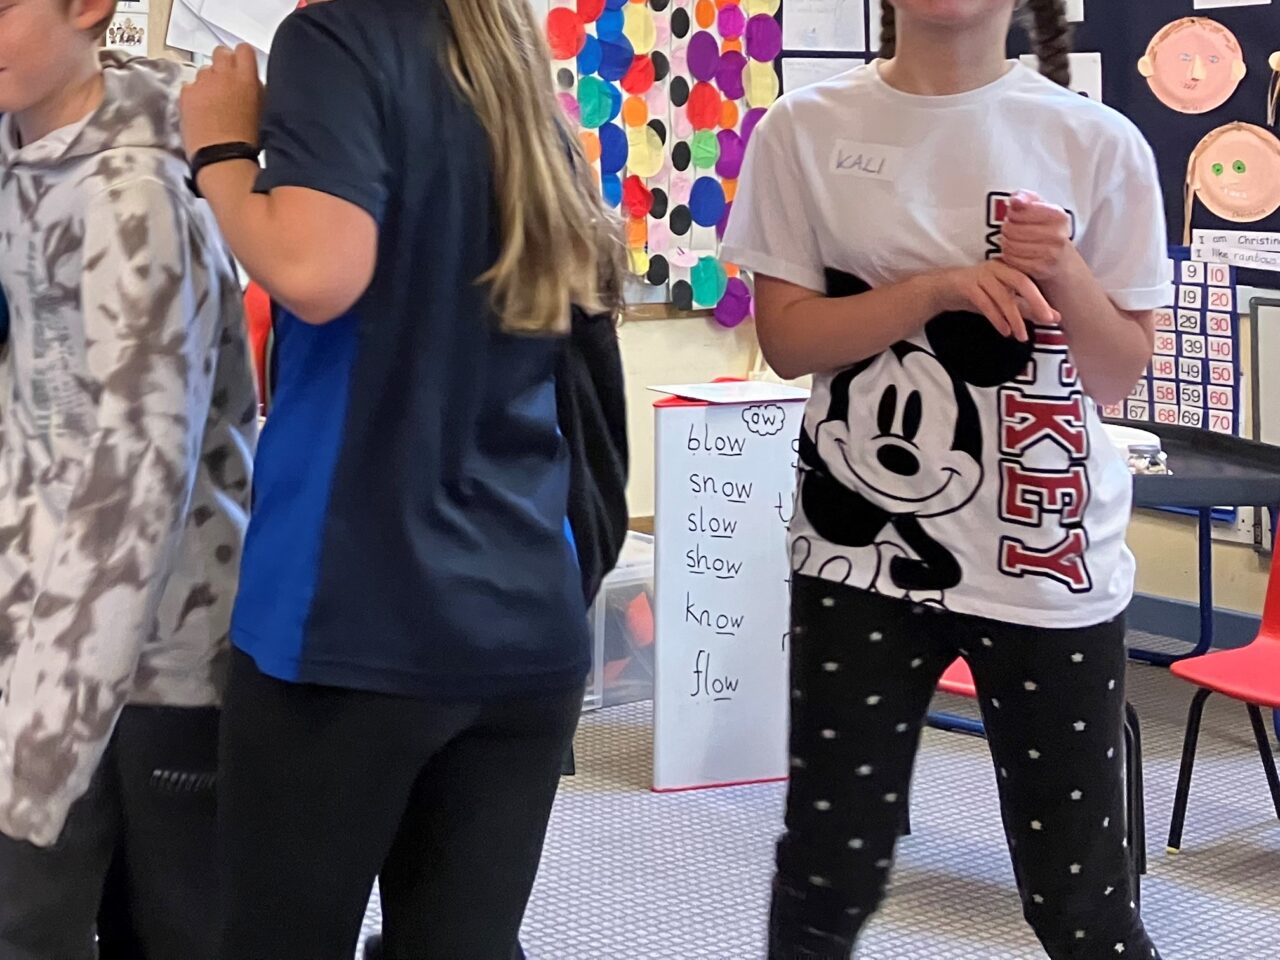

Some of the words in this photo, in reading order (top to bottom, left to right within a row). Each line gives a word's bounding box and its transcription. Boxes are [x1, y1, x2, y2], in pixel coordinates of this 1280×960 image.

[835, 149, 886, 174] KALI
[1199, 235, 1204, 244] I
[1212, 235, 1227, 243] am
[1238, 235, 1280, 246] Christin
[1196, 249, 1201, 258] I
[1212, 248, 1229, 259] like
[1187, 265, 1197, 278] 9
[1210, 268, 1224, 282] 10
[1183, 290, 1196, 303] 19
[1211, 293, 1229, 306] 20
[1155, 313, 1172, 326] 28
[1180, 316, 1198, 330] 29
[1210, 318, 1229, 332] 30
[1157, 337, 1174, 351] 38
[1184, 340, 1203, 354] 39
[1210, 342, 1230, 356] 40
[1154, 361, 1172, 374] 48
[1181, 364, 1200, 378] 49
[1212, 367, 1231, 381] 50
[1156, 386, 1174, 400] 58
[1182, 388, 1200, 402] 59
[1210, 392, 1229, 406] 60
[1129, 404, 1146, 418] 67
[1158, 409, 1176, 423] 68
[1182, 410, 1200, 424] 69
[751, 412, 776, 426] ow
[1211, 415, 1230, 429] 70
[687, 422, 746, 452] blow
[689, 473, 753, 499] snow
[688, 508, 737, 535] slow
[686, 544, 742, 576] show
[685, 591, 744, 630] know
[690, 649, 739, 697] flow
